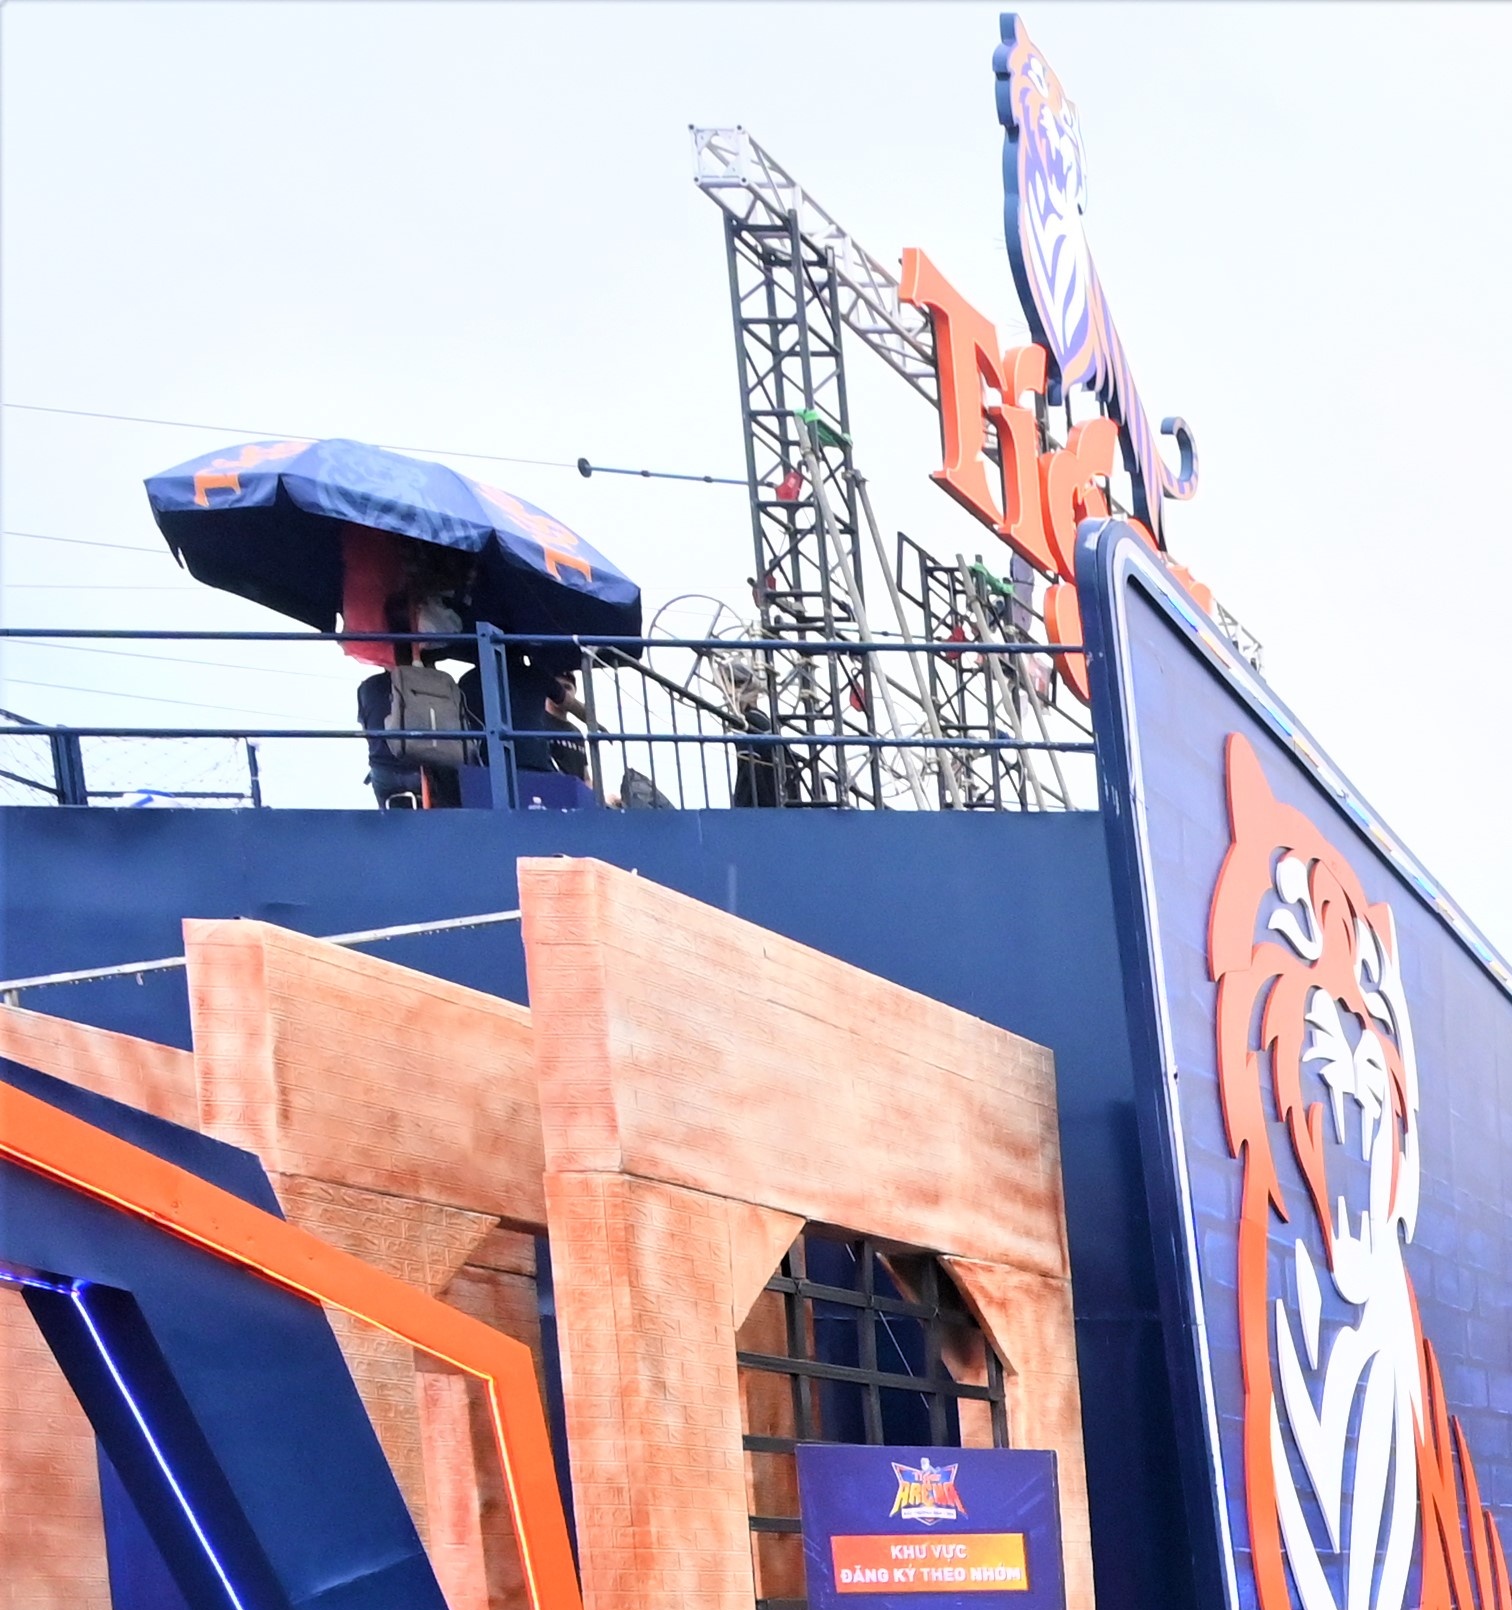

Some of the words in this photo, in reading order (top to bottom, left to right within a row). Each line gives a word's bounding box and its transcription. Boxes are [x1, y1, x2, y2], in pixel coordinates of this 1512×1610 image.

[889, 1481, 969, 1520] ARENA
[890, 1545, 927, 1559] KHU
[930, 1543, 968, 1562] VỰC
[840, 1565, 889, 1584] ĐĂNG
[893, 1563, 917, 1583] KÝ
[920, 1567, 967, 1582] THEO
[970, 1562, 1021, 1582] NHÓM
